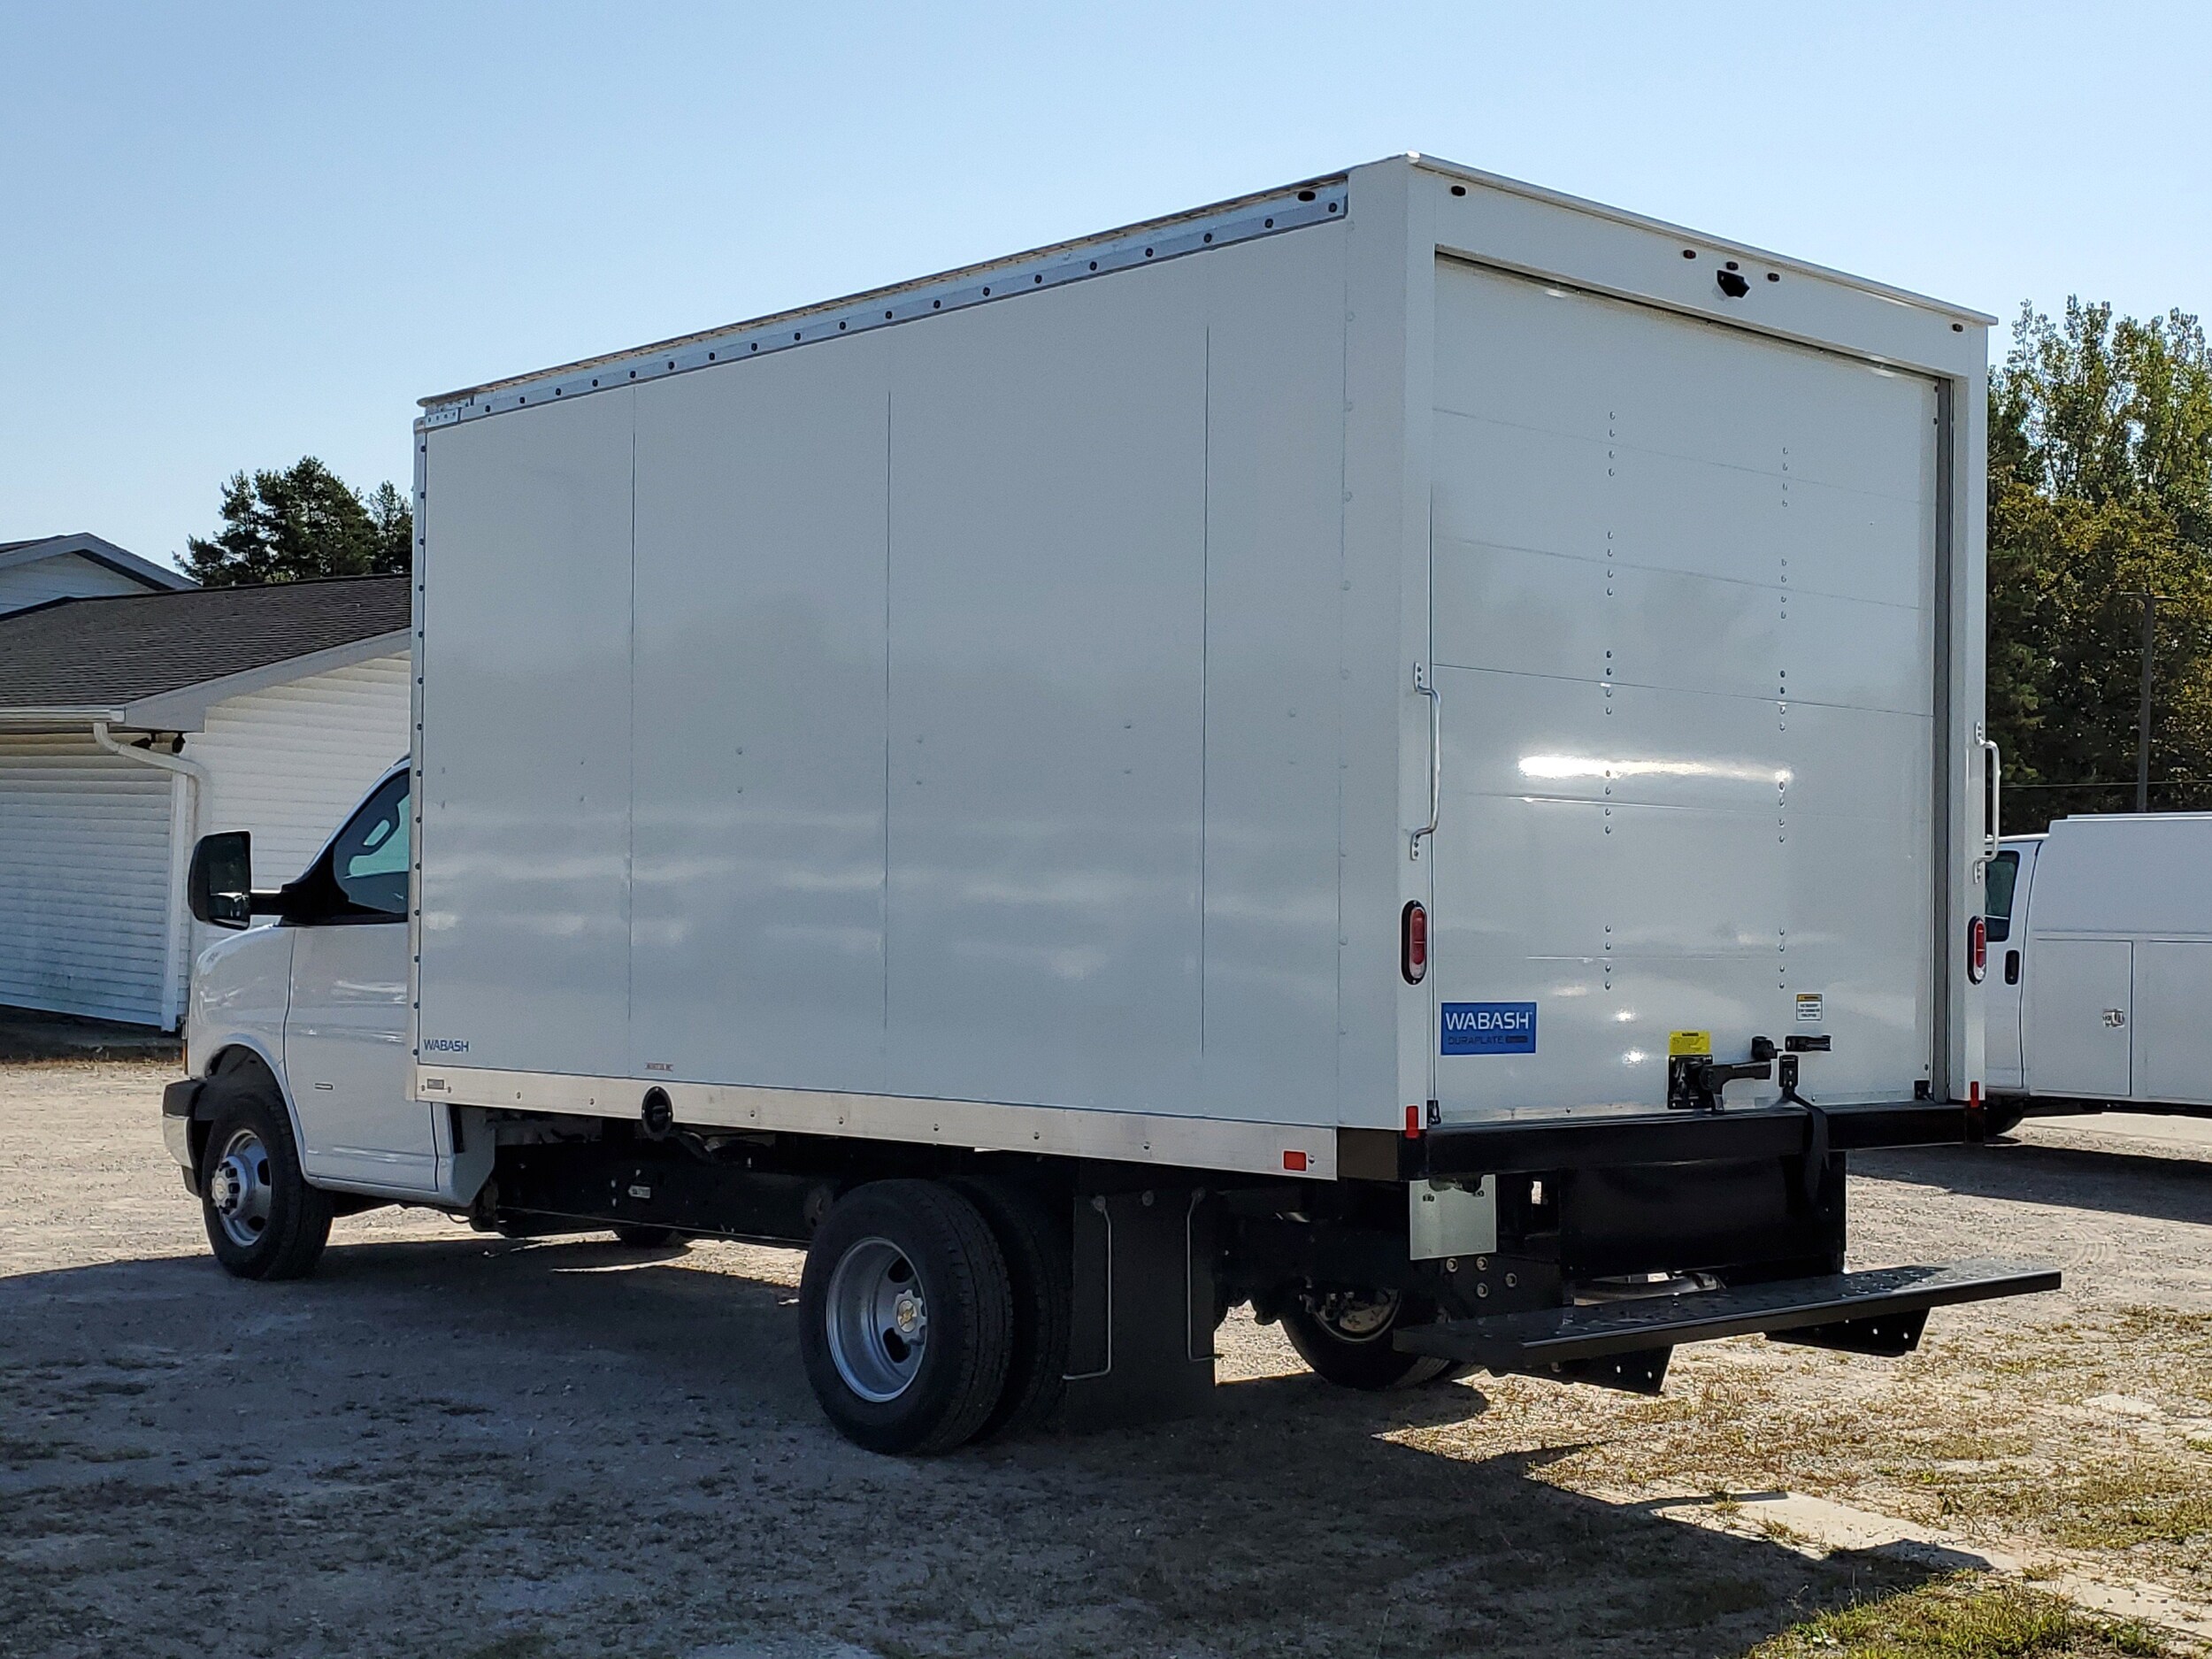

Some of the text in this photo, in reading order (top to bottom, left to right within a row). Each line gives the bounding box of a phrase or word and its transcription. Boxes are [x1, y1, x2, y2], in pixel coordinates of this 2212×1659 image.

[1446, 1012, 1529, 1030] WABASH
[424, 1039, 469, 1052] WABASH
[1448, 1036, 1503, 1045] DURAPLATE
